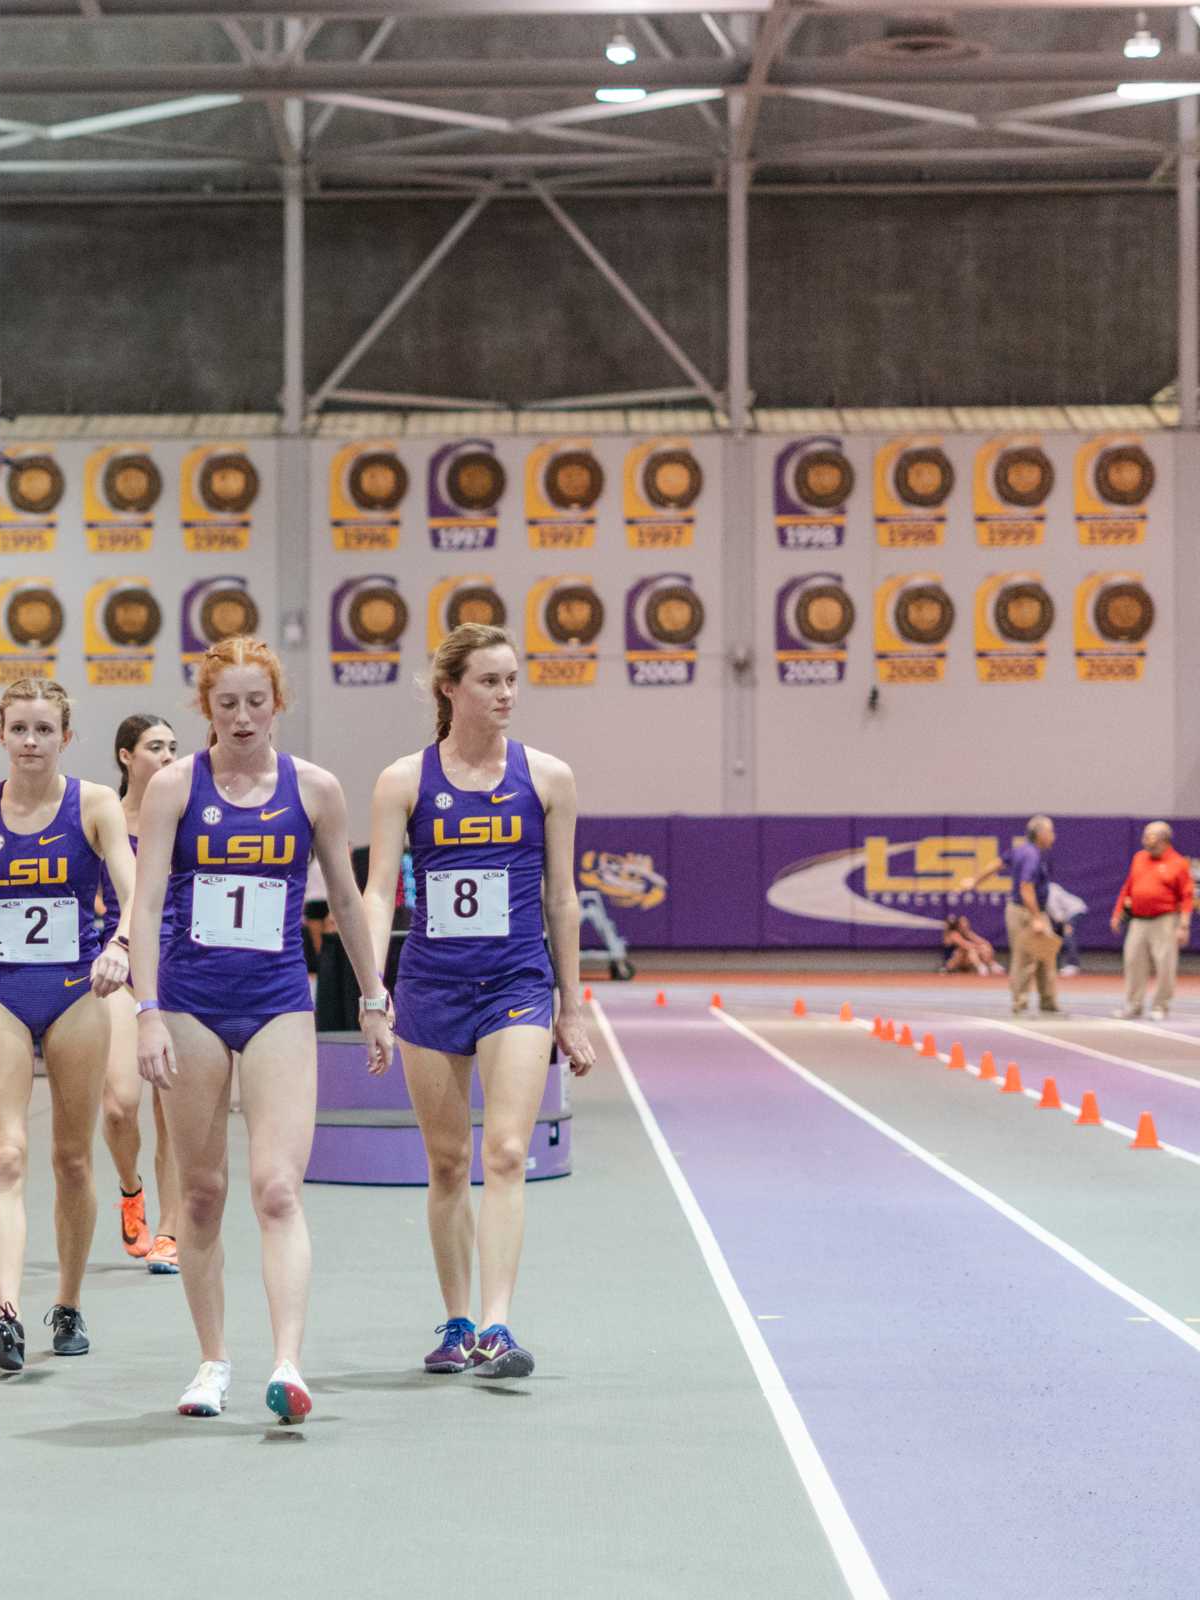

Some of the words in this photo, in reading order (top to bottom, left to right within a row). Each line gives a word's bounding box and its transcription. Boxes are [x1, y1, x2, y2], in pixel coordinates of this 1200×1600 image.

[343, 528, 393, 547] 1996
[439, 529, 487, 548] 1997
[539, 526, 585, 546] 1997
[636, 526, 684, 546] 1997
[786, 525, 837, 546] 1998
[539, 662, 585, 682] 2007
[634, 662, 687, 684] 2008
[784, 661, 837, 682] 2008
[433, 816, 522, 846] LSU
[197, 835, 296, 865] LSU
[226, 886, 245, 928] 1
[453, 878, 479, 918] 8
[25, 906, 49, 945] 2
